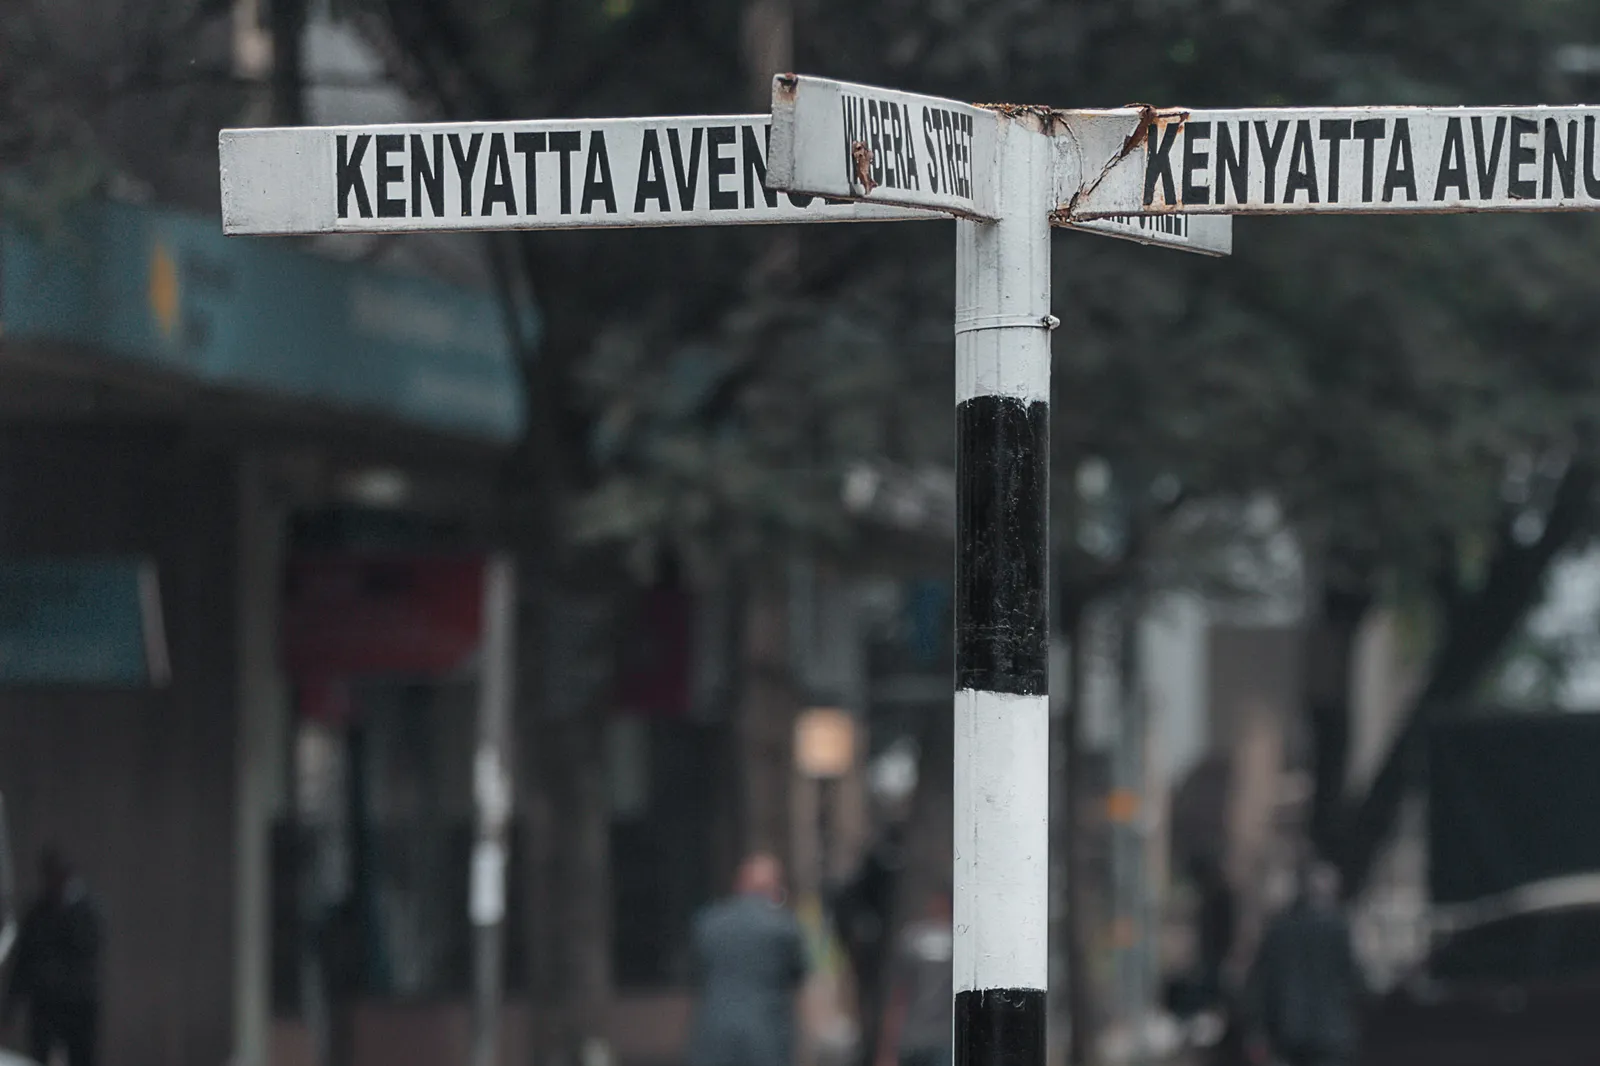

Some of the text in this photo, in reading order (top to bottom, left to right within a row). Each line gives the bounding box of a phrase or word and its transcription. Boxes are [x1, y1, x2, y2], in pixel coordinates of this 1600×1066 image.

[336, 125, 854, 219] KENYATTA AVEN
[922, 105, 975, 200] STREET
[1143, 117, 1419, 207] KENYATTA
